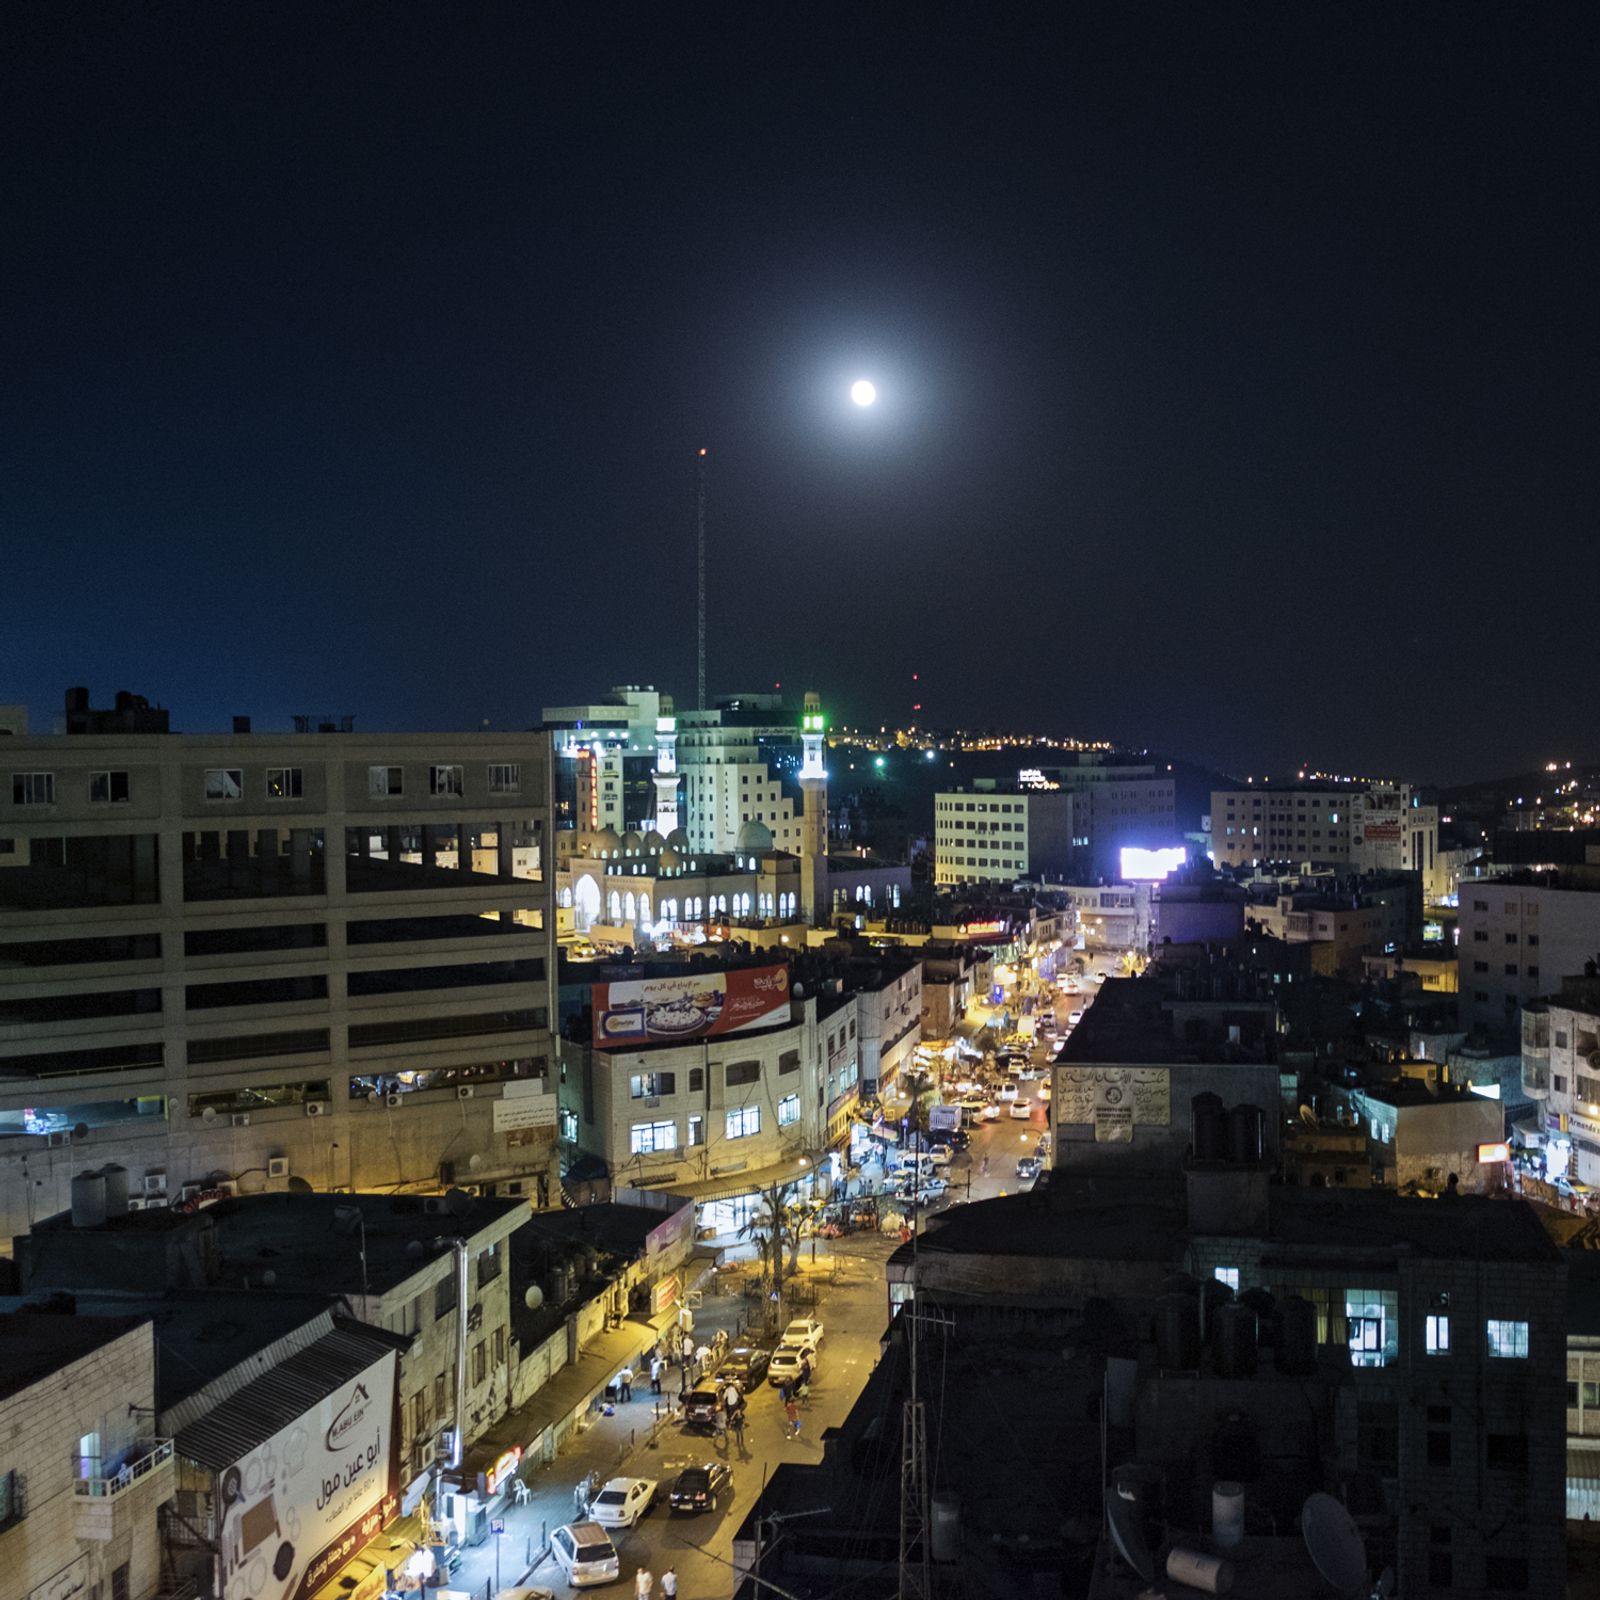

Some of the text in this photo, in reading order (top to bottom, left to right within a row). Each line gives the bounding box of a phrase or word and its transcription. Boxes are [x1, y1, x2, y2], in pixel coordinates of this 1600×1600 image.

[366, 1426, 381, 1470] أبو
[343, 1453, 364, 1488] عين
[316, 1472, 341, 1512] مول
